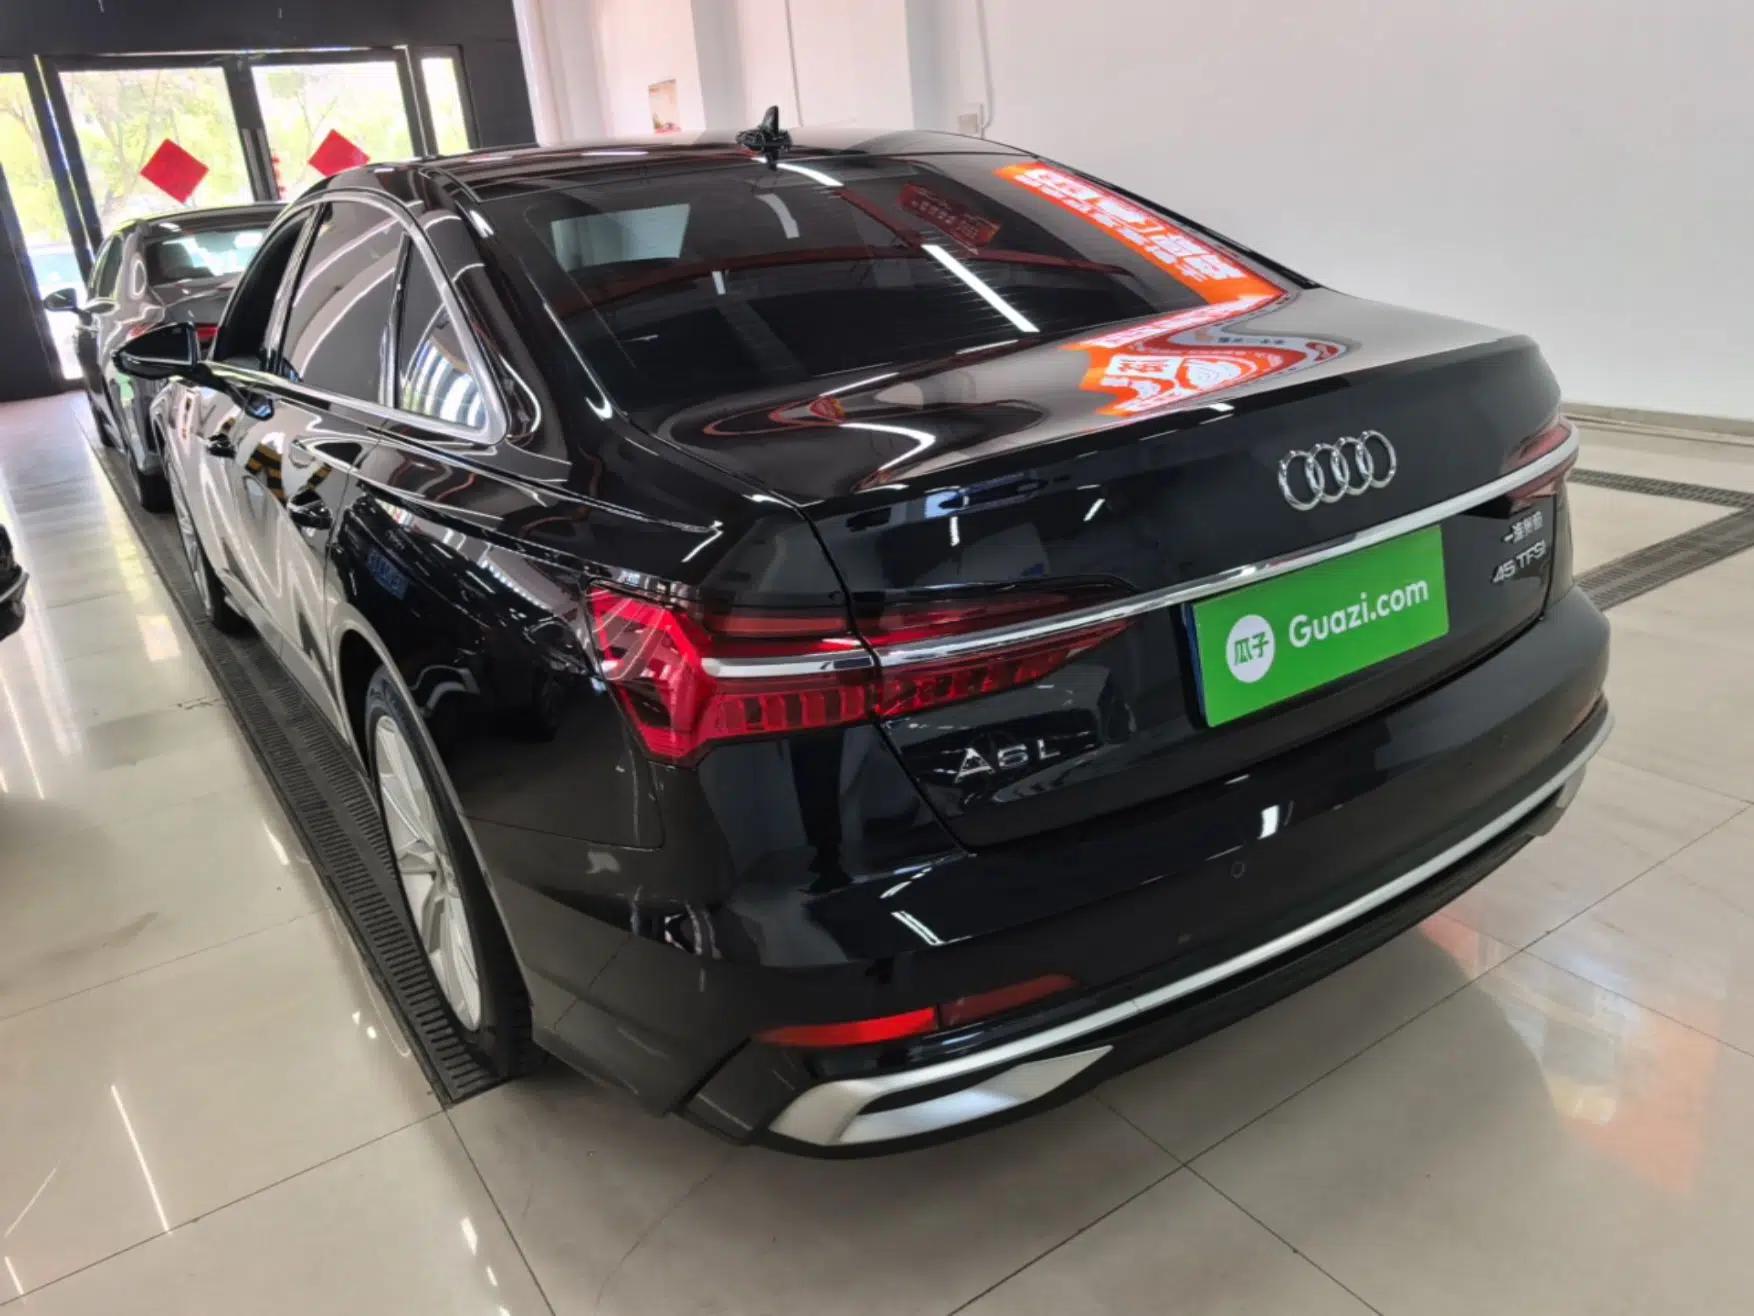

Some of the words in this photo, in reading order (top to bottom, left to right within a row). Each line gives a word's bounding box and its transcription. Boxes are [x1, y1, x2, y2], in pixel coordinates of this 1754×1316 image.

[1493, 559, 1516, 583] 45
[1288, 579, 1430, 649] Guazi.com
[1233, 631, 1270, 667] 瓜子
